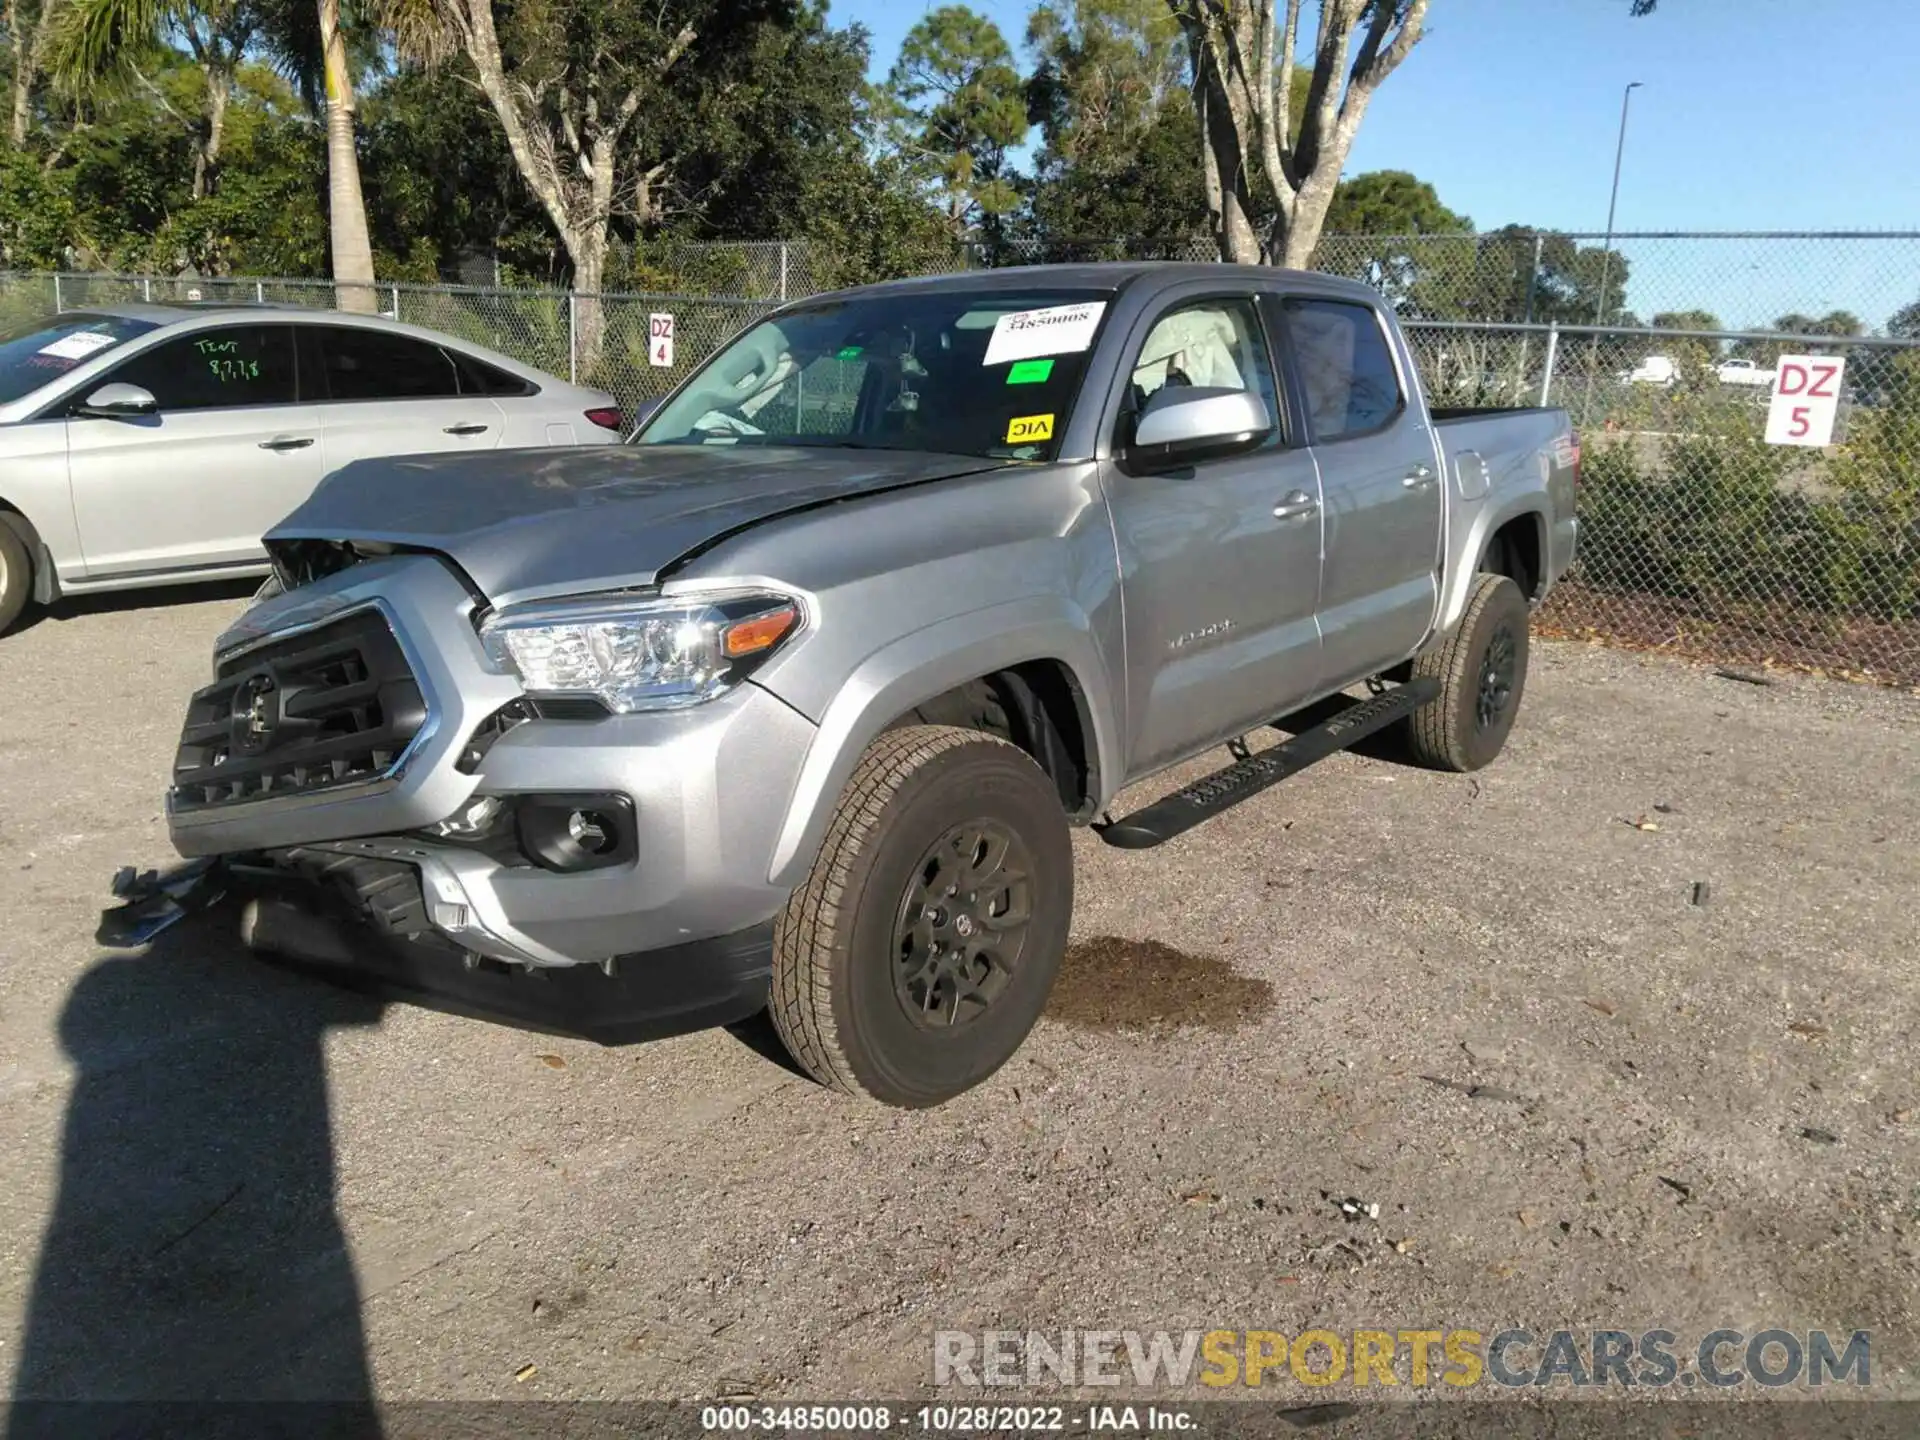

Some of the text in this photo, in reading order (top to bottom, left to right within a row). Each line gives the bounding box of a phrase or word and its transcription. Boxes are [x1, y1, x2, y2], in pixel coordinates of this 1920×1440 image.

[652, 318, 671, 338] DZ
[657, 344, 666, 362] 4
[1778, 364, 1837, 397] DZ
[1013, 421, 1048, 436] VIC
[1788, 407, 1810, 436] 5
